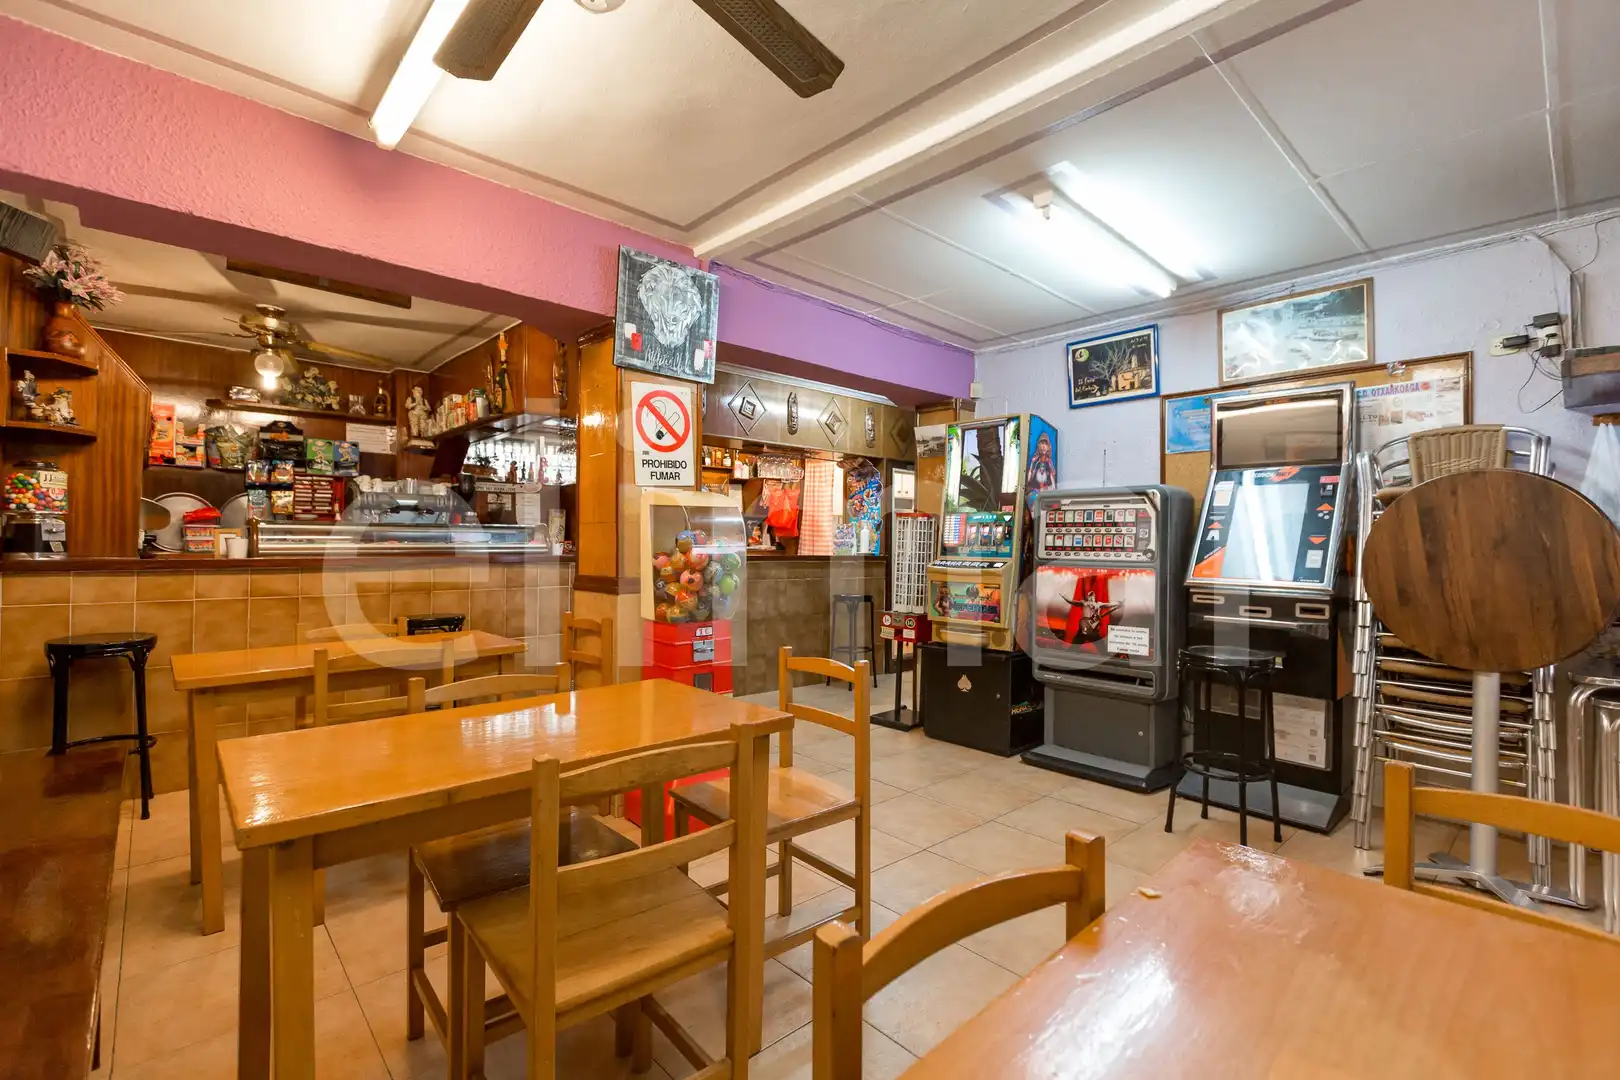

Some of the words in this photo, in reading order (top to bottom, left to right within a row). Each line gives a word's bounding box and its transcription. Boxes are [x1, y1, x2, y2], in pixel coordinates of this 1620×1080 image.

[1371, 382, 1420, 397] OTXARKOAGA
[642, 459, 687, 469] PROHIBIDO
[650, 471, 681, 480] FUMAR
